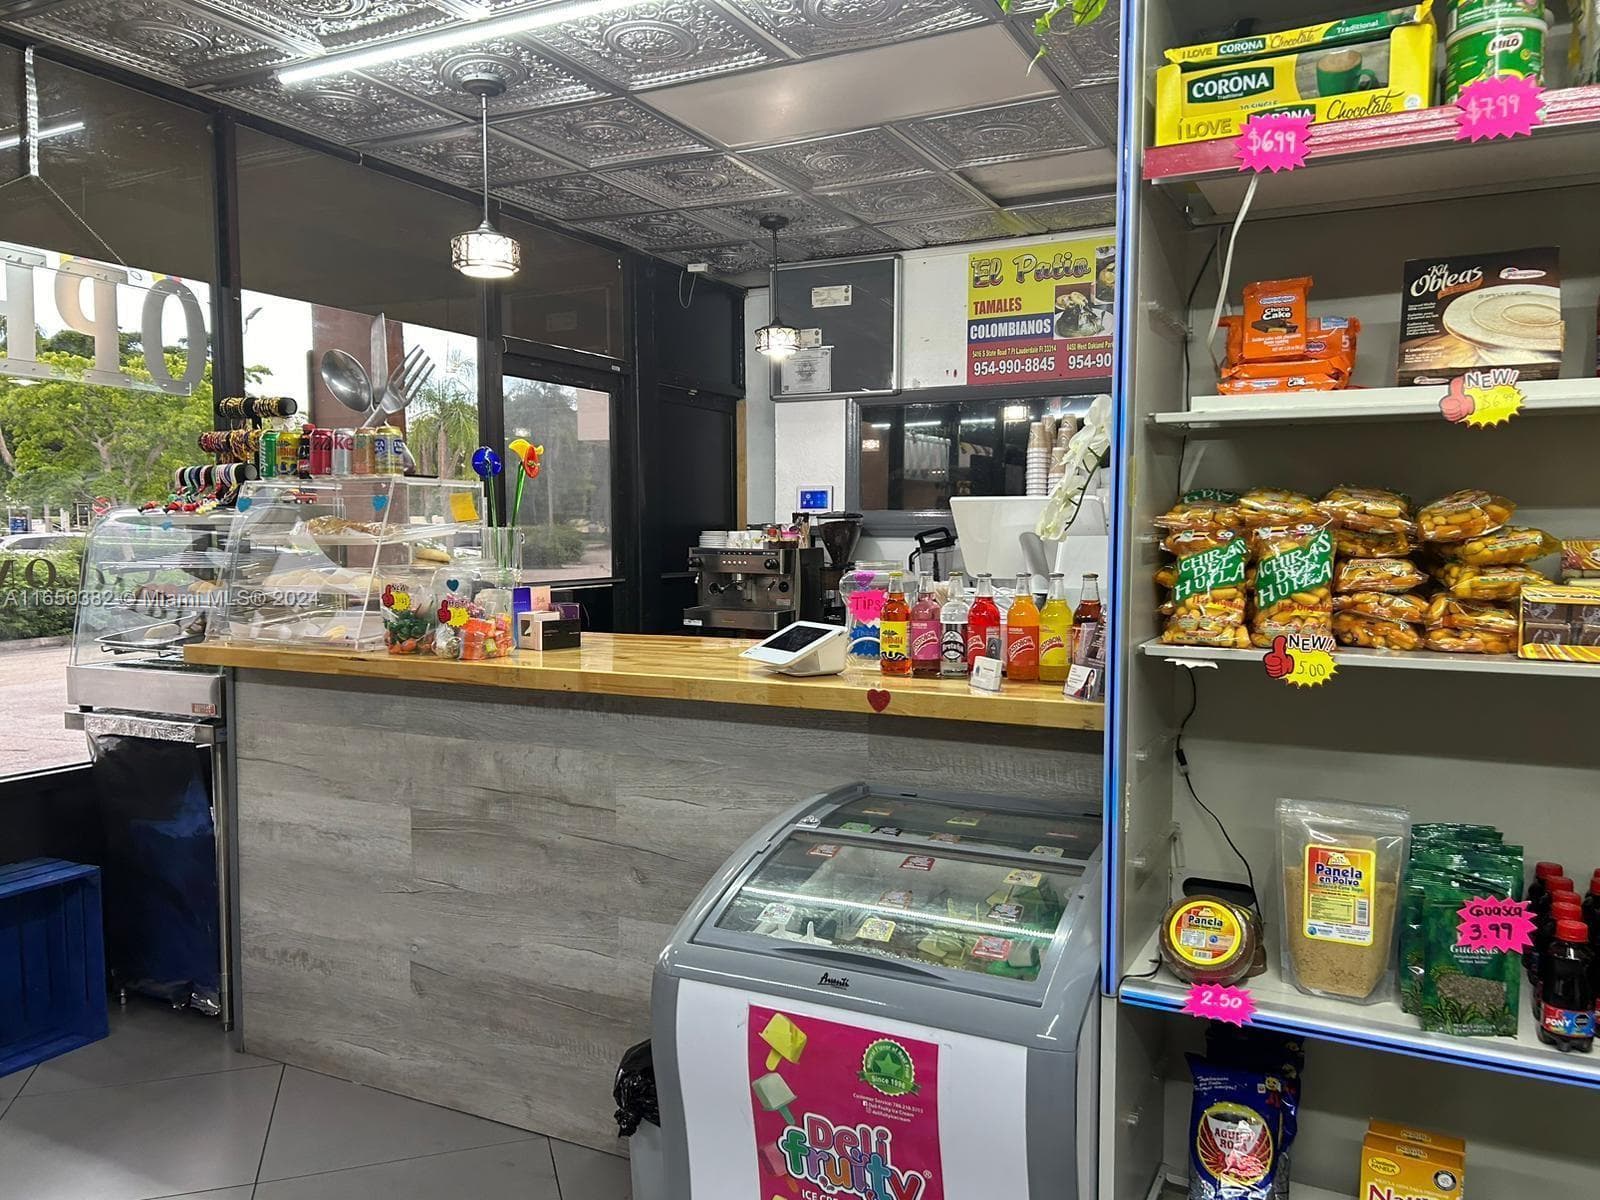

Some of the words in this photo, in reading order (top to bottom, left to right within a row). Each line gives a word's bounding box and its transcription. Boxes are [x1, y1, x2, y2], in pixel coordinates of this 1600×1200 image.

[1337, 20, 1379, 34] Traditional
[1187, 47, 1213, 58] LOVE
[1219, 39, 1265, 54] CORONA
[1270, 27, 1322, 49] Chocolate
[1491, 37, 1519, 50] MILO
[1192, 72, 1270, 98] CORONA
[1186, 118, 1233, 138] LOVE
[1326, 90, 1405, 121] Chocolate
[1466, 94, 1520, 125] $7.99
[1248, 128, 1297, 156] $6.99
[971, 257, 1004, 288] El
[1012, 252, 1092, 283] Patio
[1428, 264, 1449, 277] Kit
[1410, 266, 1483, 297] Obleas
[973, 297, 1022, 315] TAMALES
[1262, 311, 1292, 320] Cake
[970, 318, 1051, 340] COLOMBIANOS
[974, 356, 1055, 376] 954-990-8845
[1466, 369, 1518, 389] NEW!
[1288, 634, 1334, 652] NEW!
[1297, 660, 1326, 677] 5.00
[1316, 864, 1363, 879] Panela
[1332, 876, 1360, 886] Polvo
[1469, 904, 1523, 918] Guasca
[1189, 915, 1223, 928] Panela
[1469, 923, 1513, 941] 3.99
[1201, 990, 1242, 1009] 2.50
[1545, 1016, 1571, 1027] PONY
[806, 1115, 888, 1164] Deli
[782, 1128, 922, 1200] fruity
